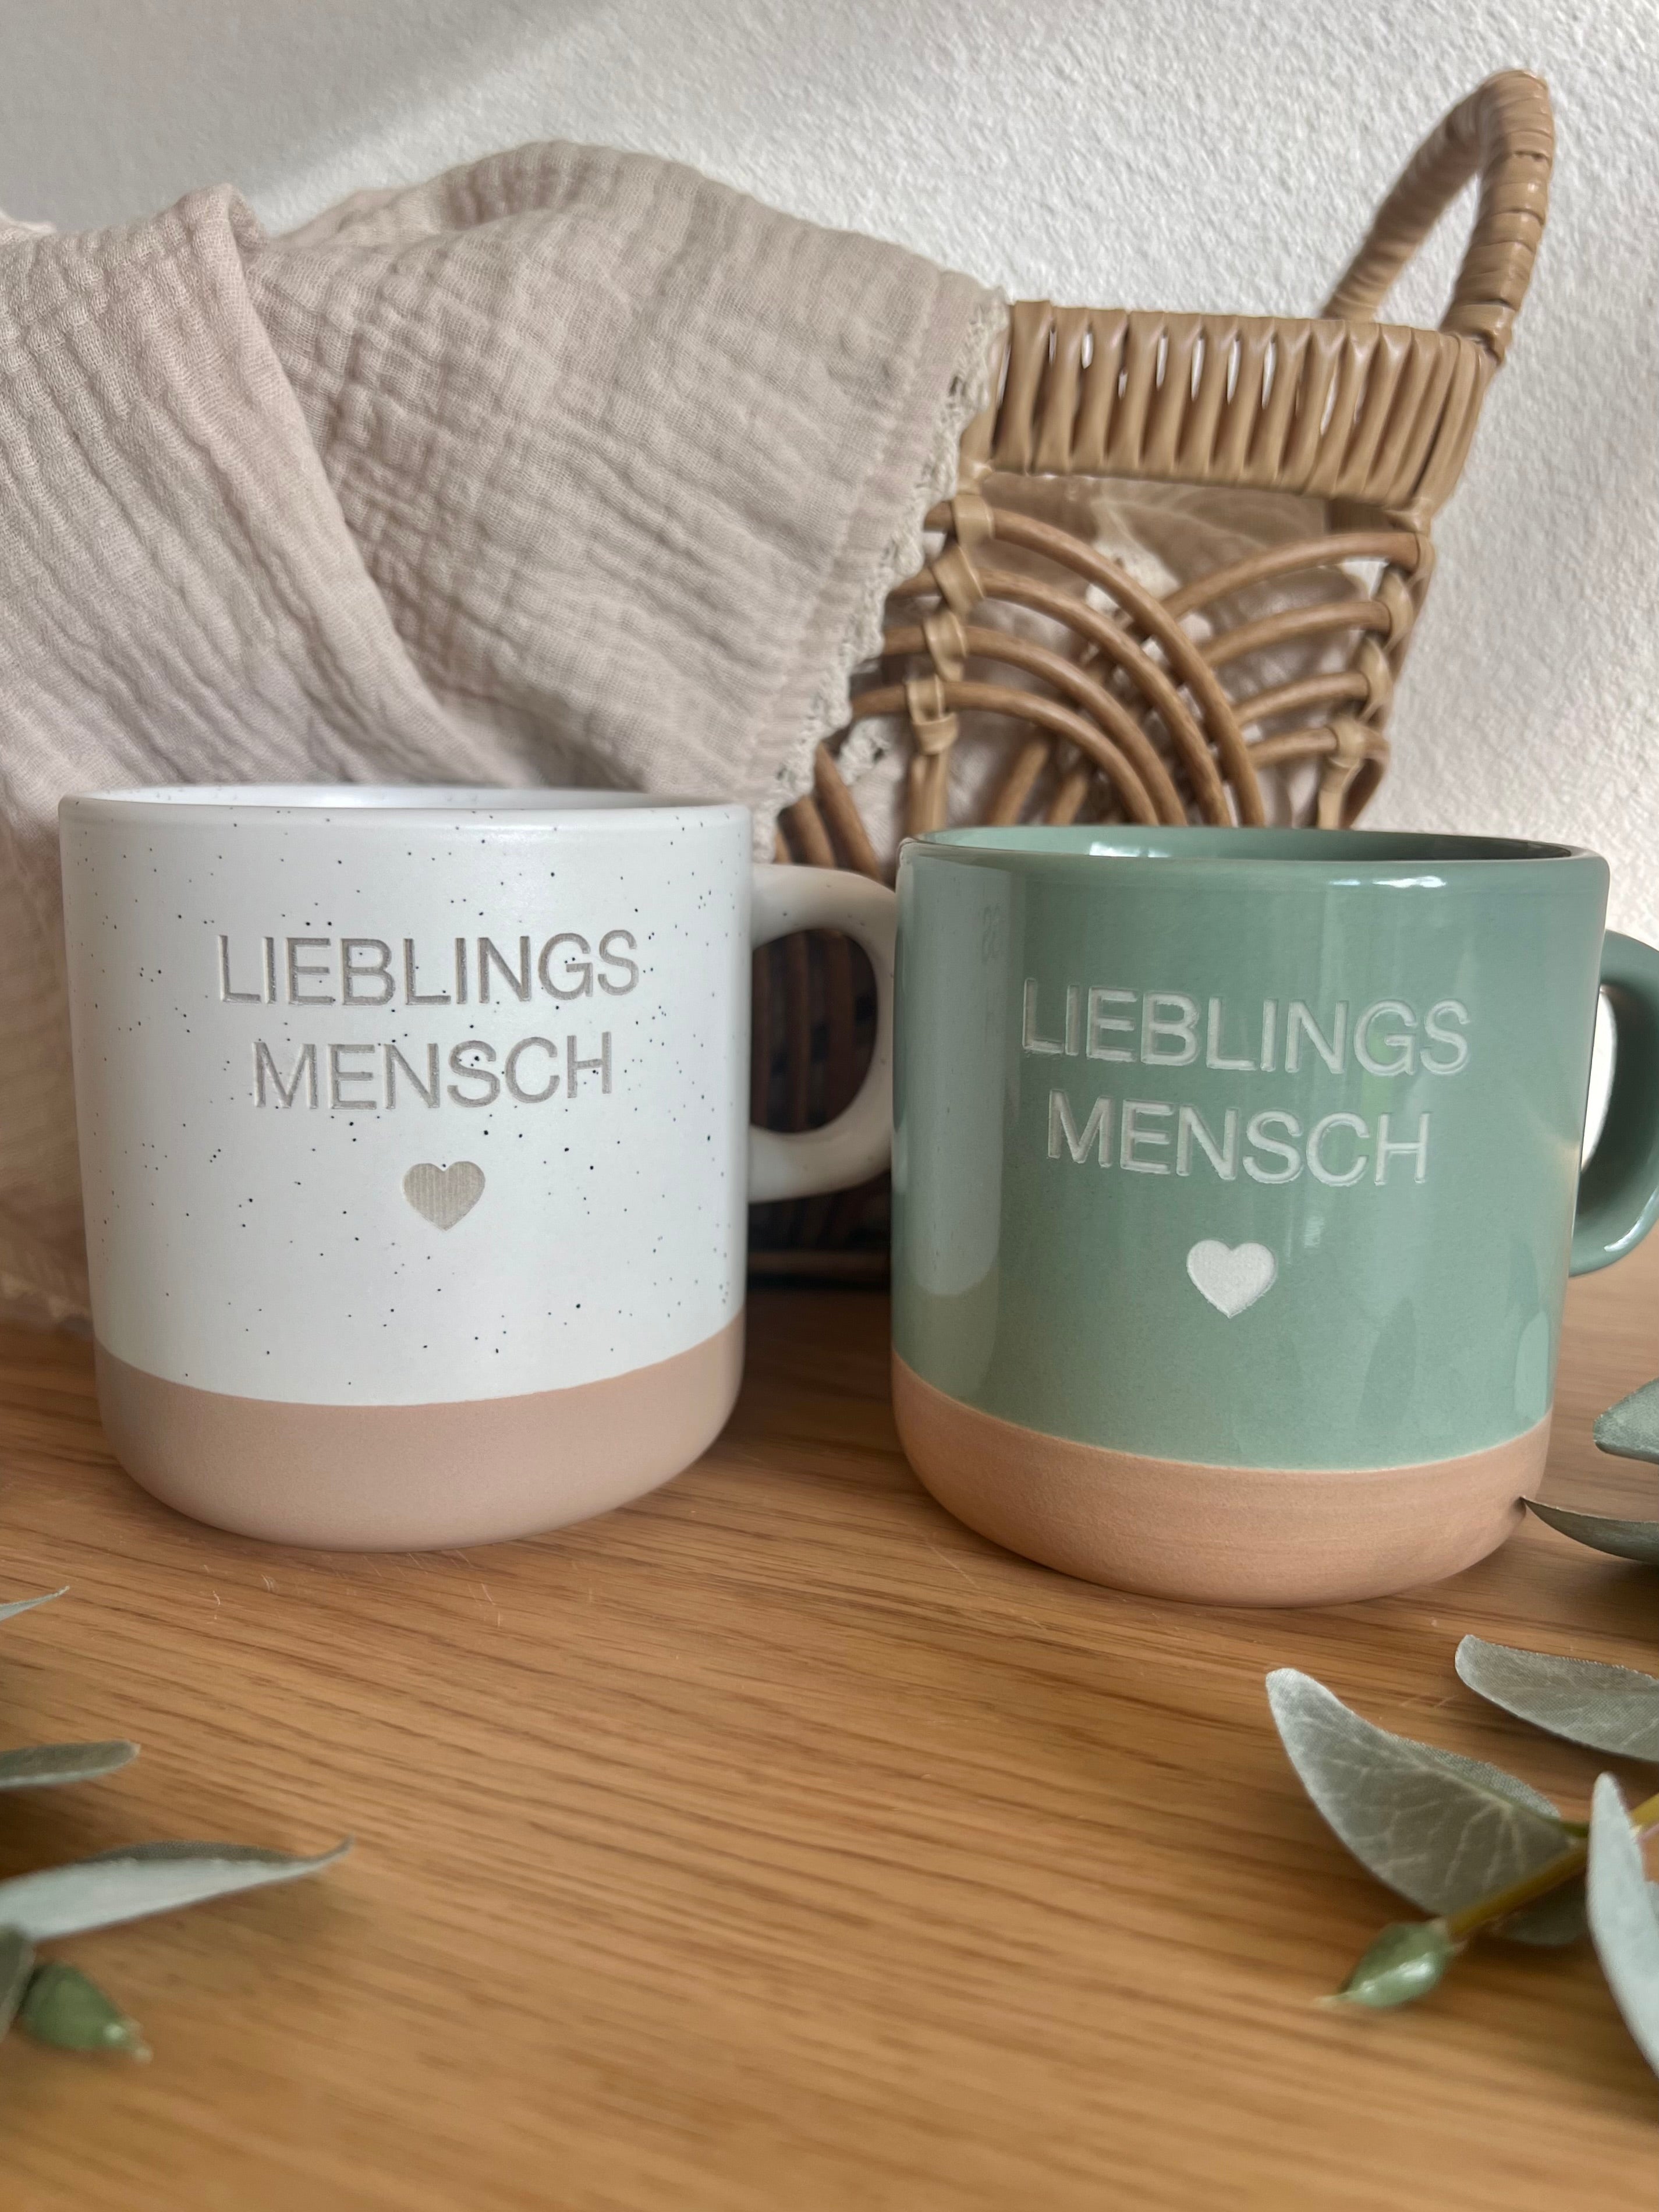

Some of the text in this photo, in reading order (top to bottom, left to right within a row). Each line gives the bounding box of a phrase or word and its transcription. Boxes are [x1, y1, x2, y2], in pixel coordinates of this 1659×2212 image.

[218, 930, 639, 1006] LIEBLINGS
[252, 1031, 612, 1109] MENSCH
[1022, 978, 1470, 1077] LIEBLINGS
[1048, 1089, 1431, 1187] MENSCH
